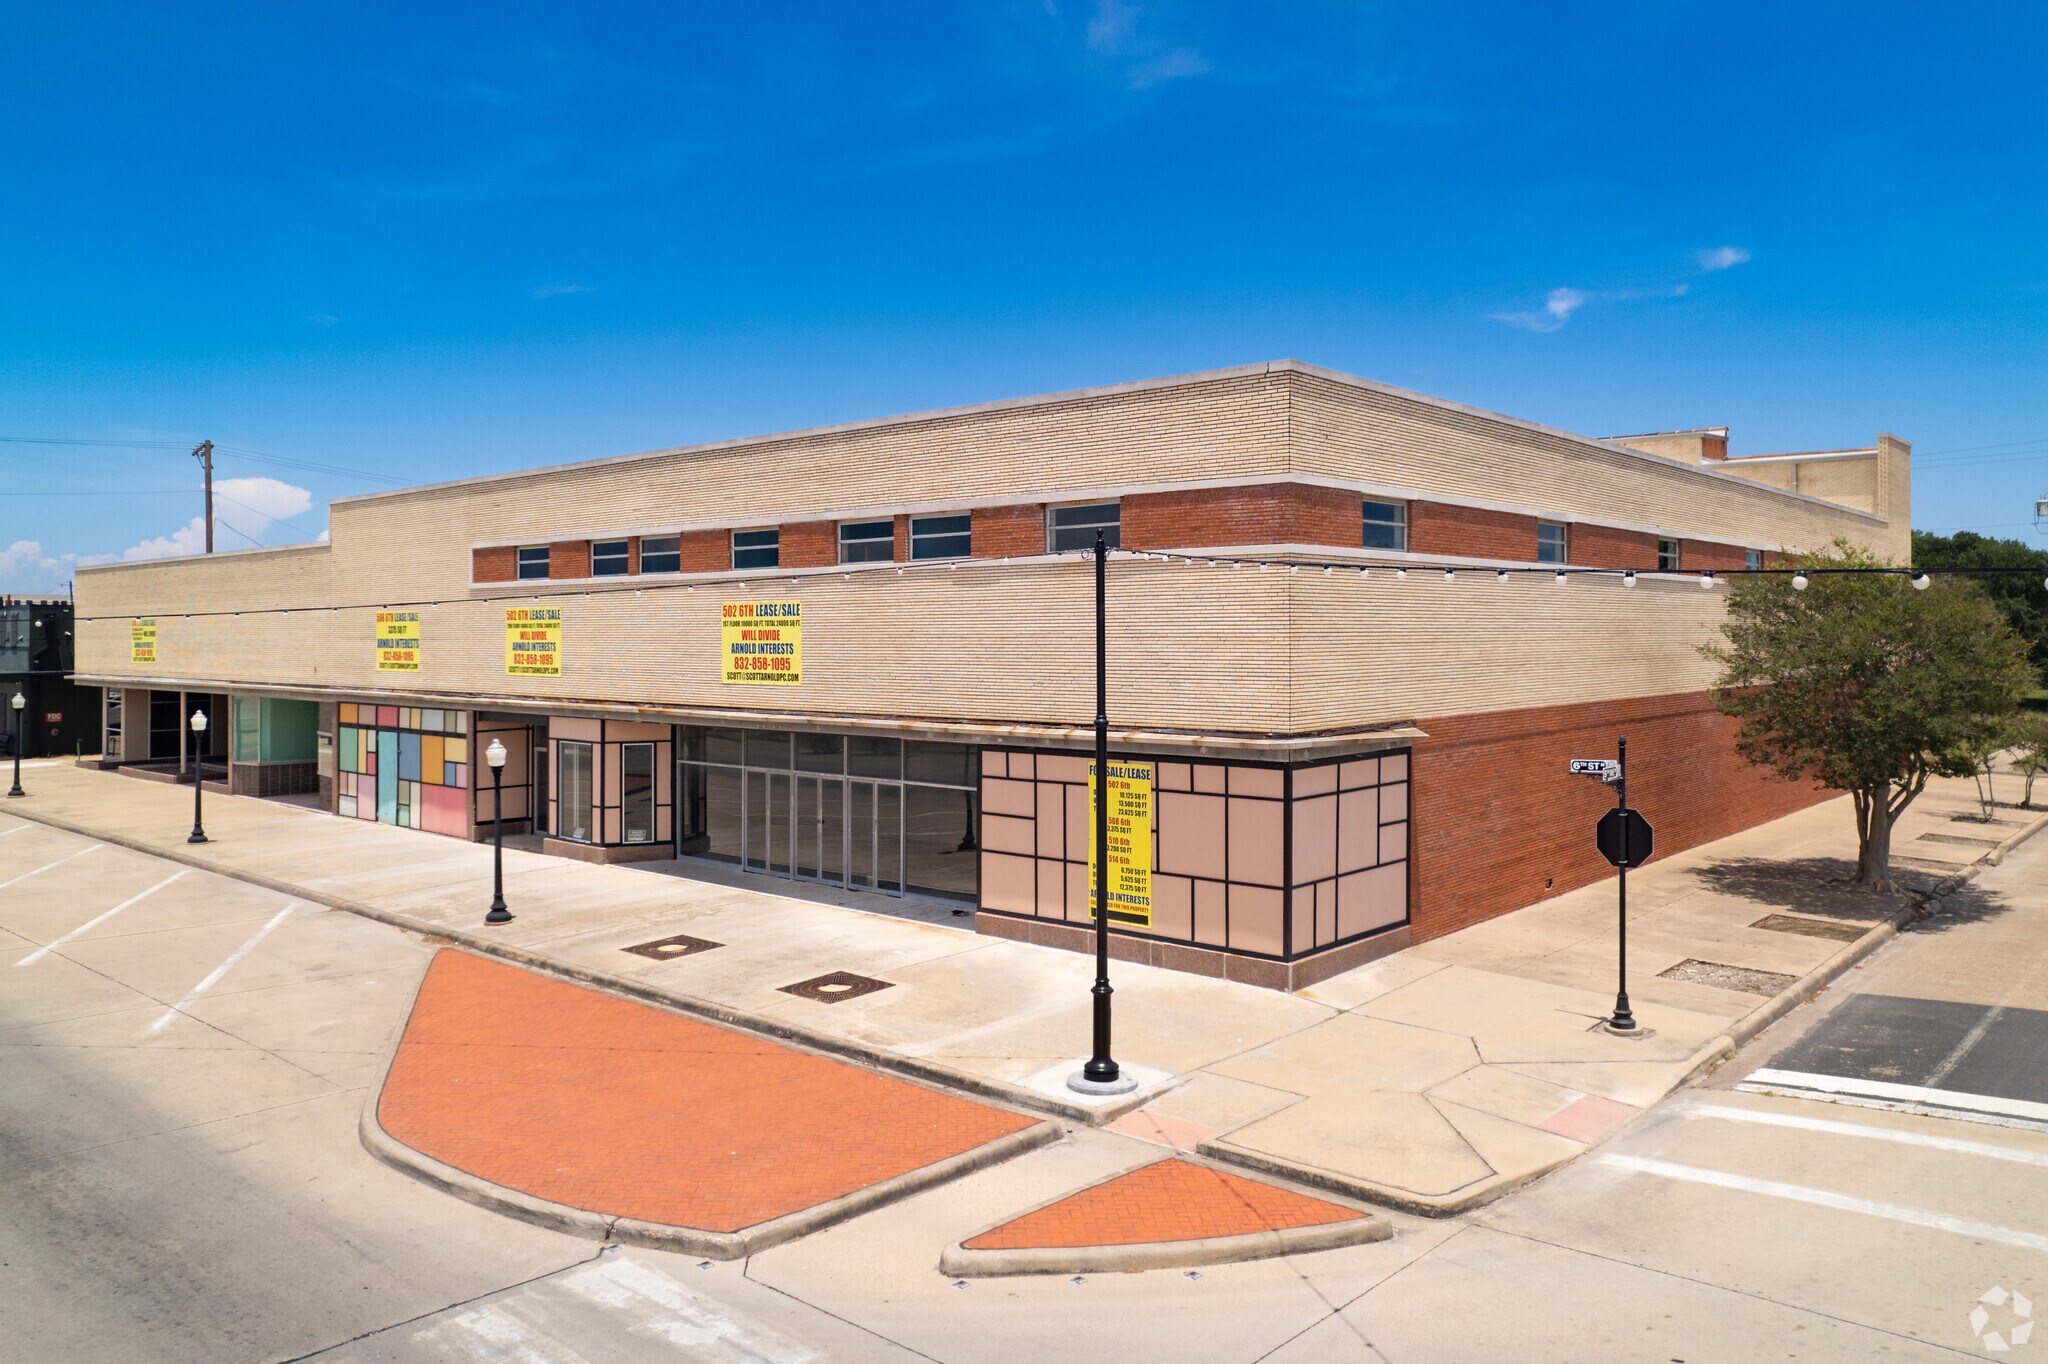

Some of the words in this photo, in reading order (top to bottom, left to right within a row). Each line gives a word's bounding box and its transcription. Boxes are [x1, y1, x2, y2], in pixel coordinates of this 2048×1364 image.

[507, 610, 516, 620] 502
[518, 610, 528, 620] 6TH
[530, 610, 560, 620] LEASE/SALE
[723, 605, 737, 617] 502
[739, 605, 754, 617] 6TH
[756, 604, 800, 616] LEASE/SALE
[520, 631, 530, 640] WILL
[532, 631, 546, 640] DIVIDE
[742, 630, 756, 640] WILL
[758, 630, 780, 640] DIVIDE
[512, 642, 530, 651] ARNOLD
[531, 642, 556, 652] INTERESTS
[731, 643, 756, 654] ARNOLD
[758, 643, 794, 654] INTERESTS
[734, 657, 790, 670] 832-858-1095
[1107, 766, 1150, 780] SALE/LEASE
[1120, 838, 1130, 846] 6th
[1109, 855, 1118, 863] 514
[1120, 856, 1130, 864] 6th
[1116, 893, 1150, 906] INTERESTS
